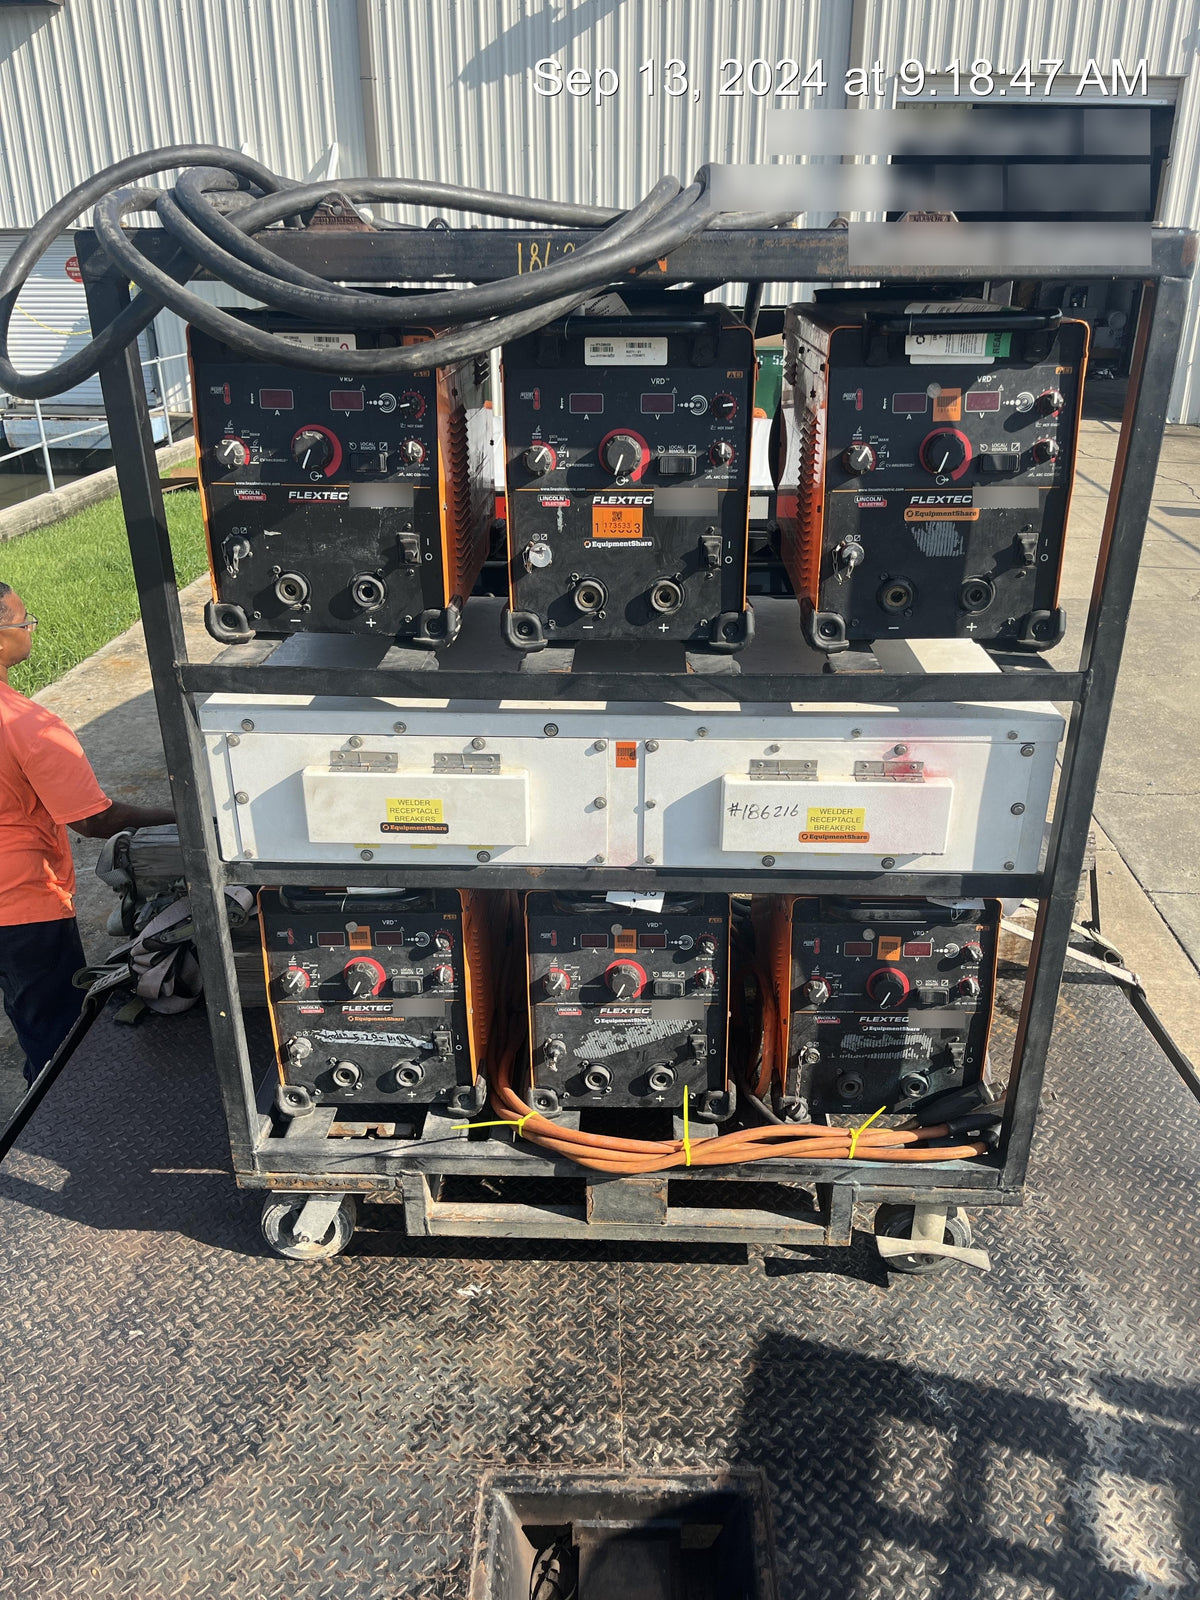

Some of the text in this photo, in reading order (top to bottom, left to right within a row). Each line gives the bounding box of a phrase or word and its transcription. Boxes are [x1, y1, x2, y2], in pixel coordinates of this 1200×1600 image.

[288, 490, 348, 500] FLEXTEC
[910, 495, 972, 504] FLEXTEC
[592, 496, 653, 505] FLEXTEC
[914, 510, 977, 518] EquipmentShare
[591, 539, 653, 548] EquipmentShare
[727, 801, 799, 820] #186216
[810, 816, 861, 824] RECEPTACLE
